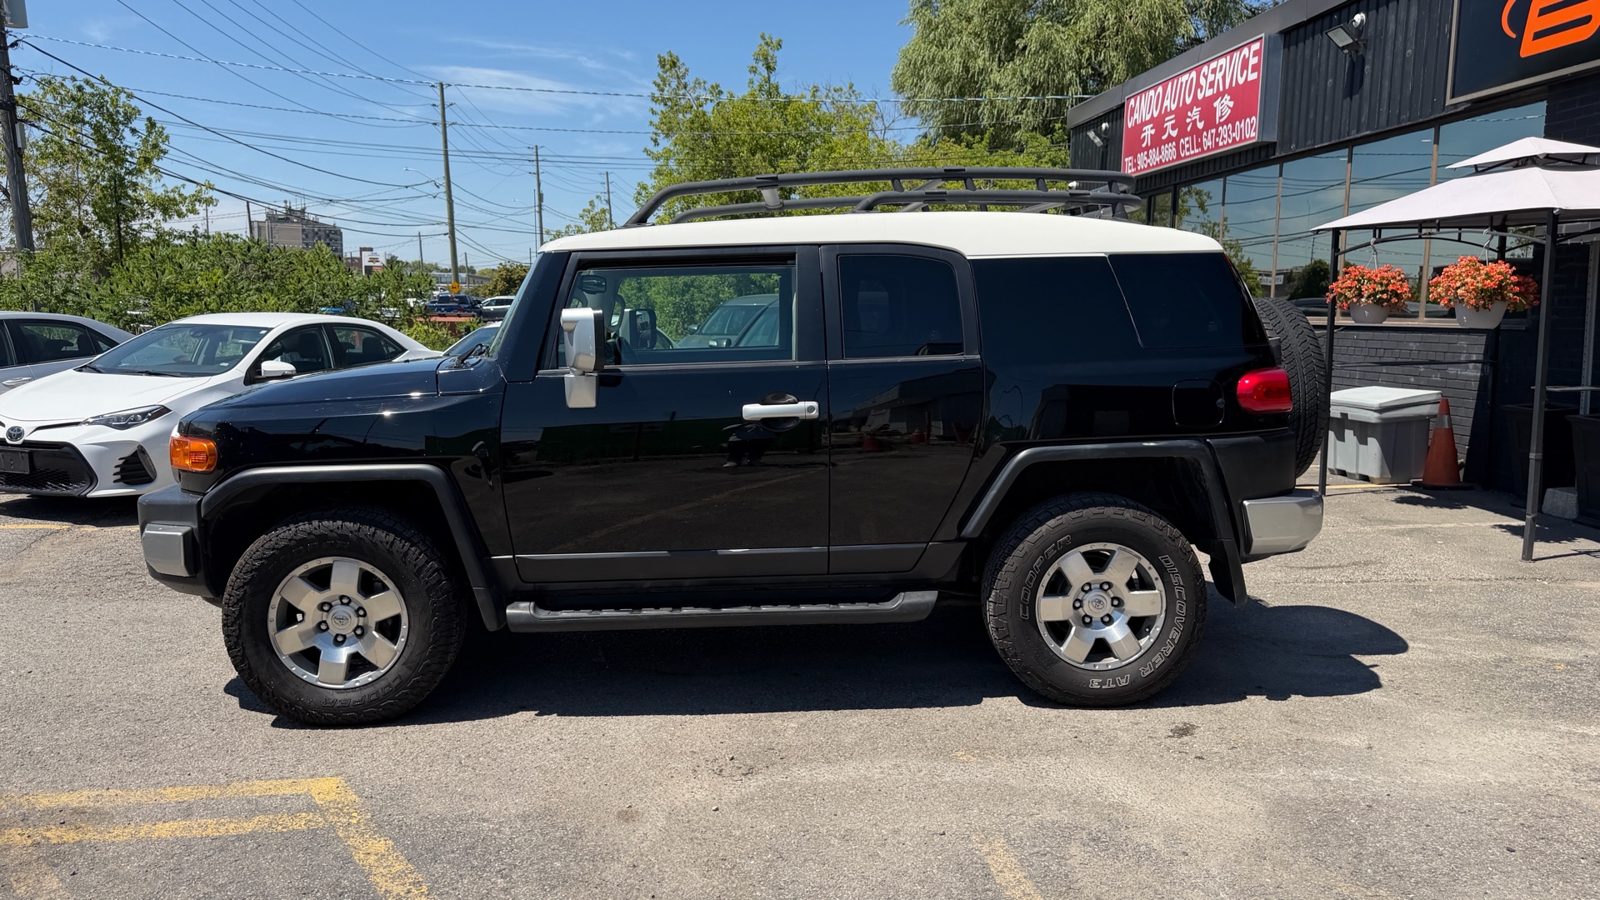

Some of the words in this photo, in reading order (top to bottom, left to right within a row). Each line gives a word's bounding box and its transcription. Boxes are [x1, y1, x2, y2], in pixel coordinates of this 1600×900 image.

[1127, 86, 1163, 128] CANDO
[1162, 71, 1197, 115] AUTO
[1197, 41, 1260, 100] SERVICE
[1140, 94, 1234, 147] 开元汽修
[1124, 156, 1137, 174] TEL:
[1179, 134, 1202, 158] CELL:
[1202, 115, 1257, 151] 647-293-0102
[1021, 534, 1072, 619] COOPER
[1139, 554, 1187, 677] DISCOVERER
[1089, 674, 1130, 688] AT3
